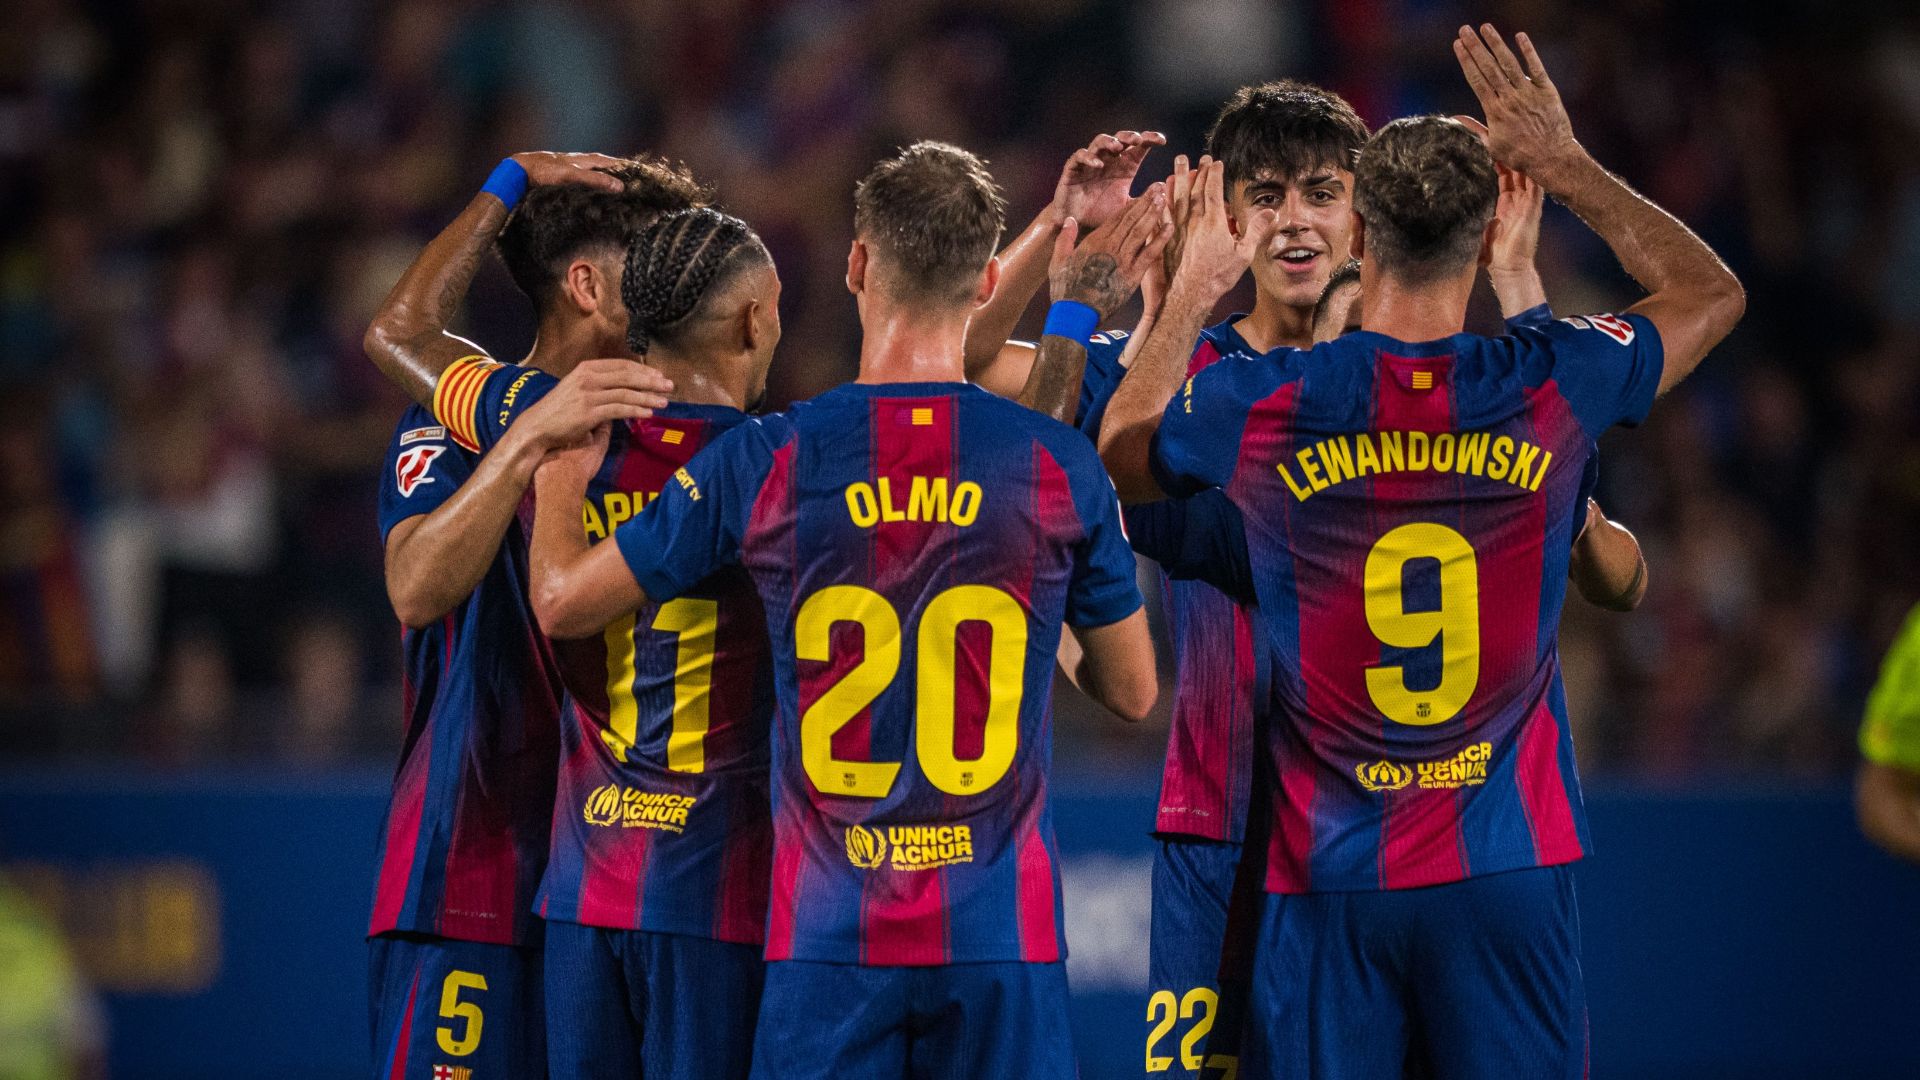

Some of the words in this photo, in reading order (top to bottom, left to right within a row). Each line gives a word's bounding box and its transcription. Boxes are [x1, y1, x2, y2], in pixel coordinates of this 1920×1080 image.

[845, 476, 984, 528] OLMO
[1276, 431, 1553, 502] LEWANDOWSKI
[1363, 522, 1480, 726] 9
[601, 598, 718, 773] 11
[795, 584, 1028, 798] 20
[622, 787, 697, 809] UNHCR
[623, 802, 688, 826] ACNUR
[888, 825, 972, 846] UNHCR
[891, 841, 974, 864] ACNUR
[436, 970, 488, 1056] 5
[1145, 987, 1219, 1073] 22
